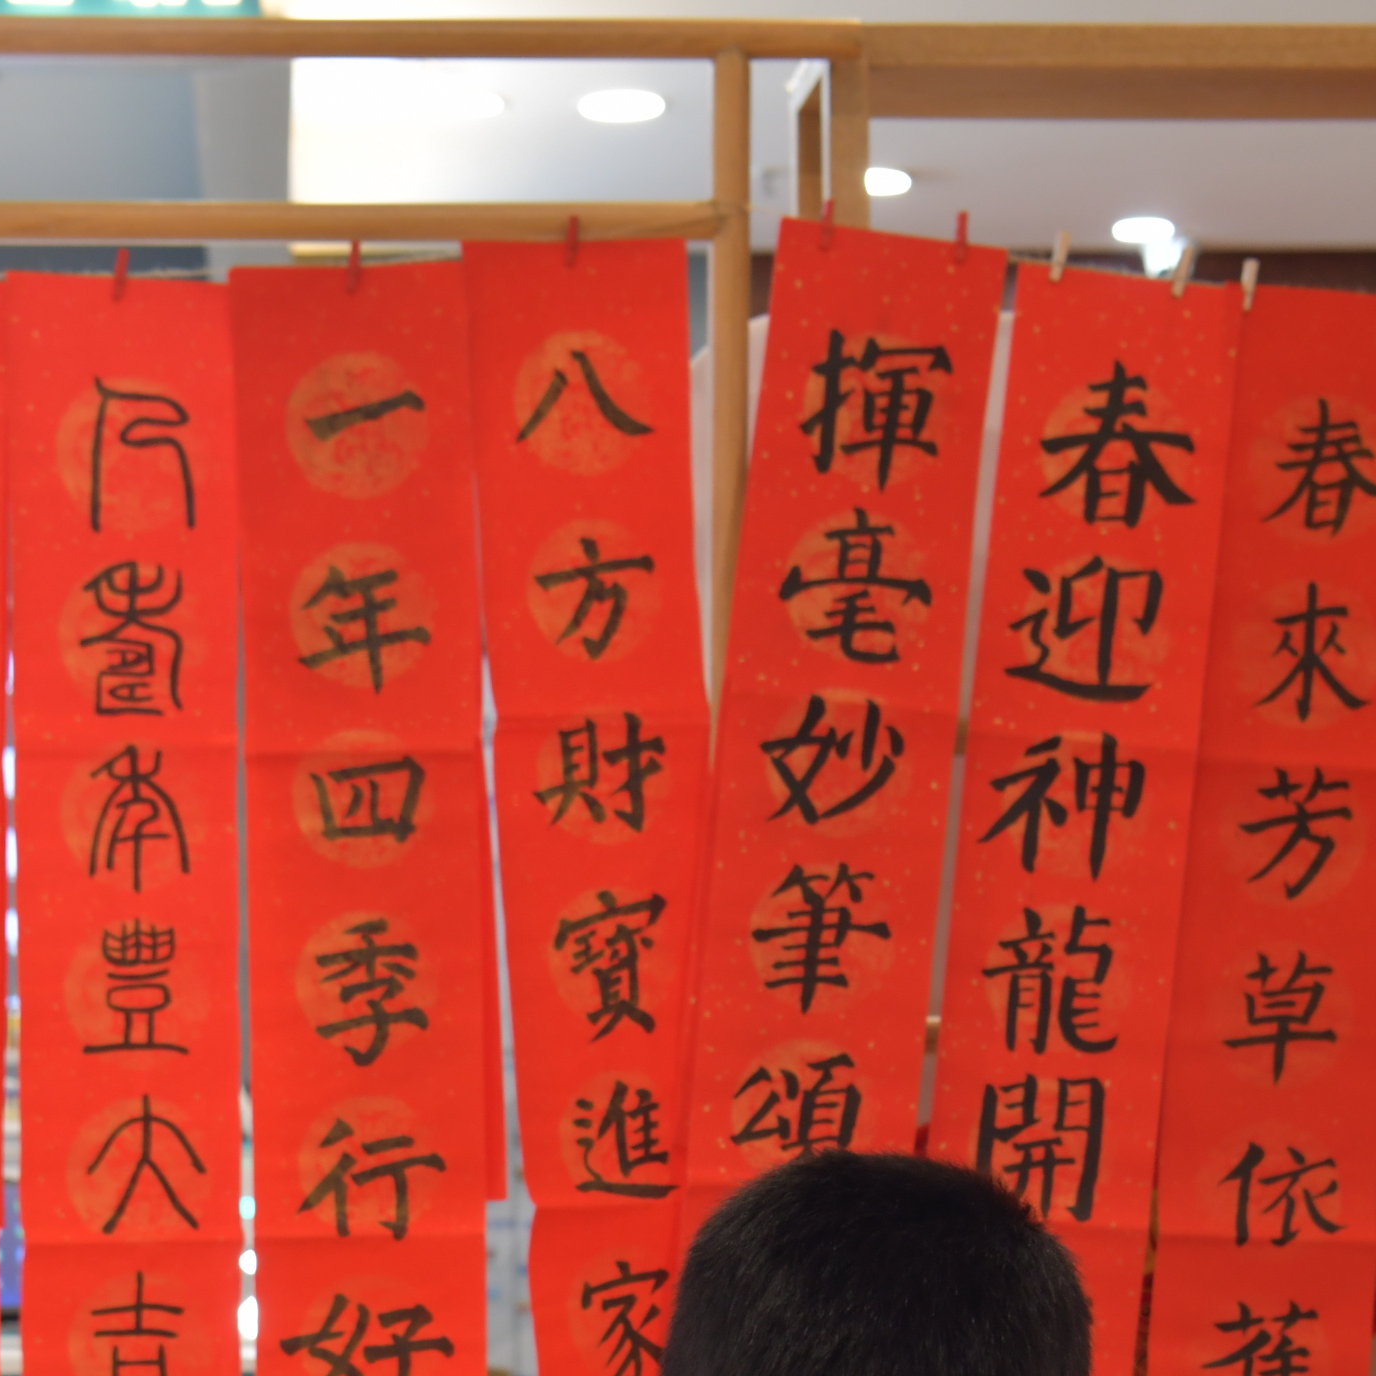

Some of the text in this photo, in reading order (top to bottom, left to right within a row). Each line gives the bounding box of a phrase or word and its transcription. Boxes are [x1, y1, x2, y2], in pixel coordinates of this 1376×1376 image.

[730, 329, 954, 1153] 揮毫妙筆頌
[976, 360, 1197, 1223] 春迎神龍開
